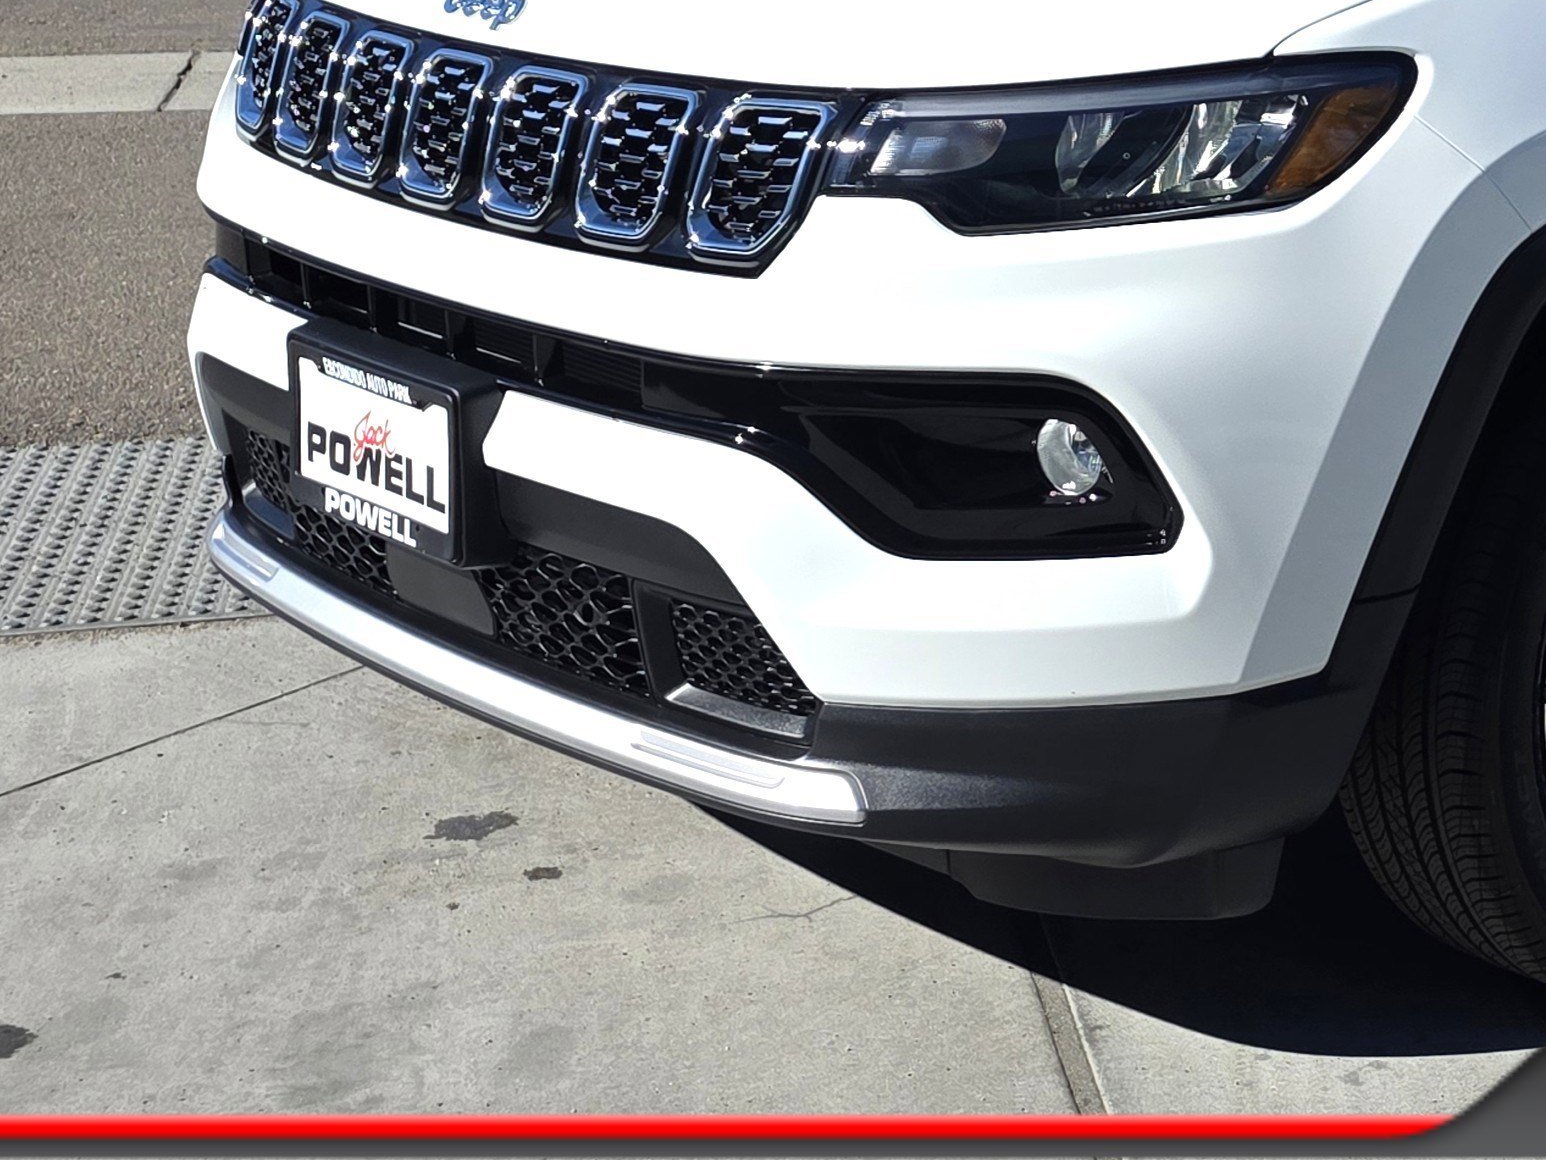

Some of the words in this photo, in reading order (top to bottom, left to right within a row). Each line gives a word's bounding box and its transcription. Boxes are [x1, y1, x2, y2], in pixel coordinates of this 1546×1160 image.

[353, 411, 396, 462] Jack
[307, 421, 446, 514] POWELL
[324, 487, 417, 548] POWELL
